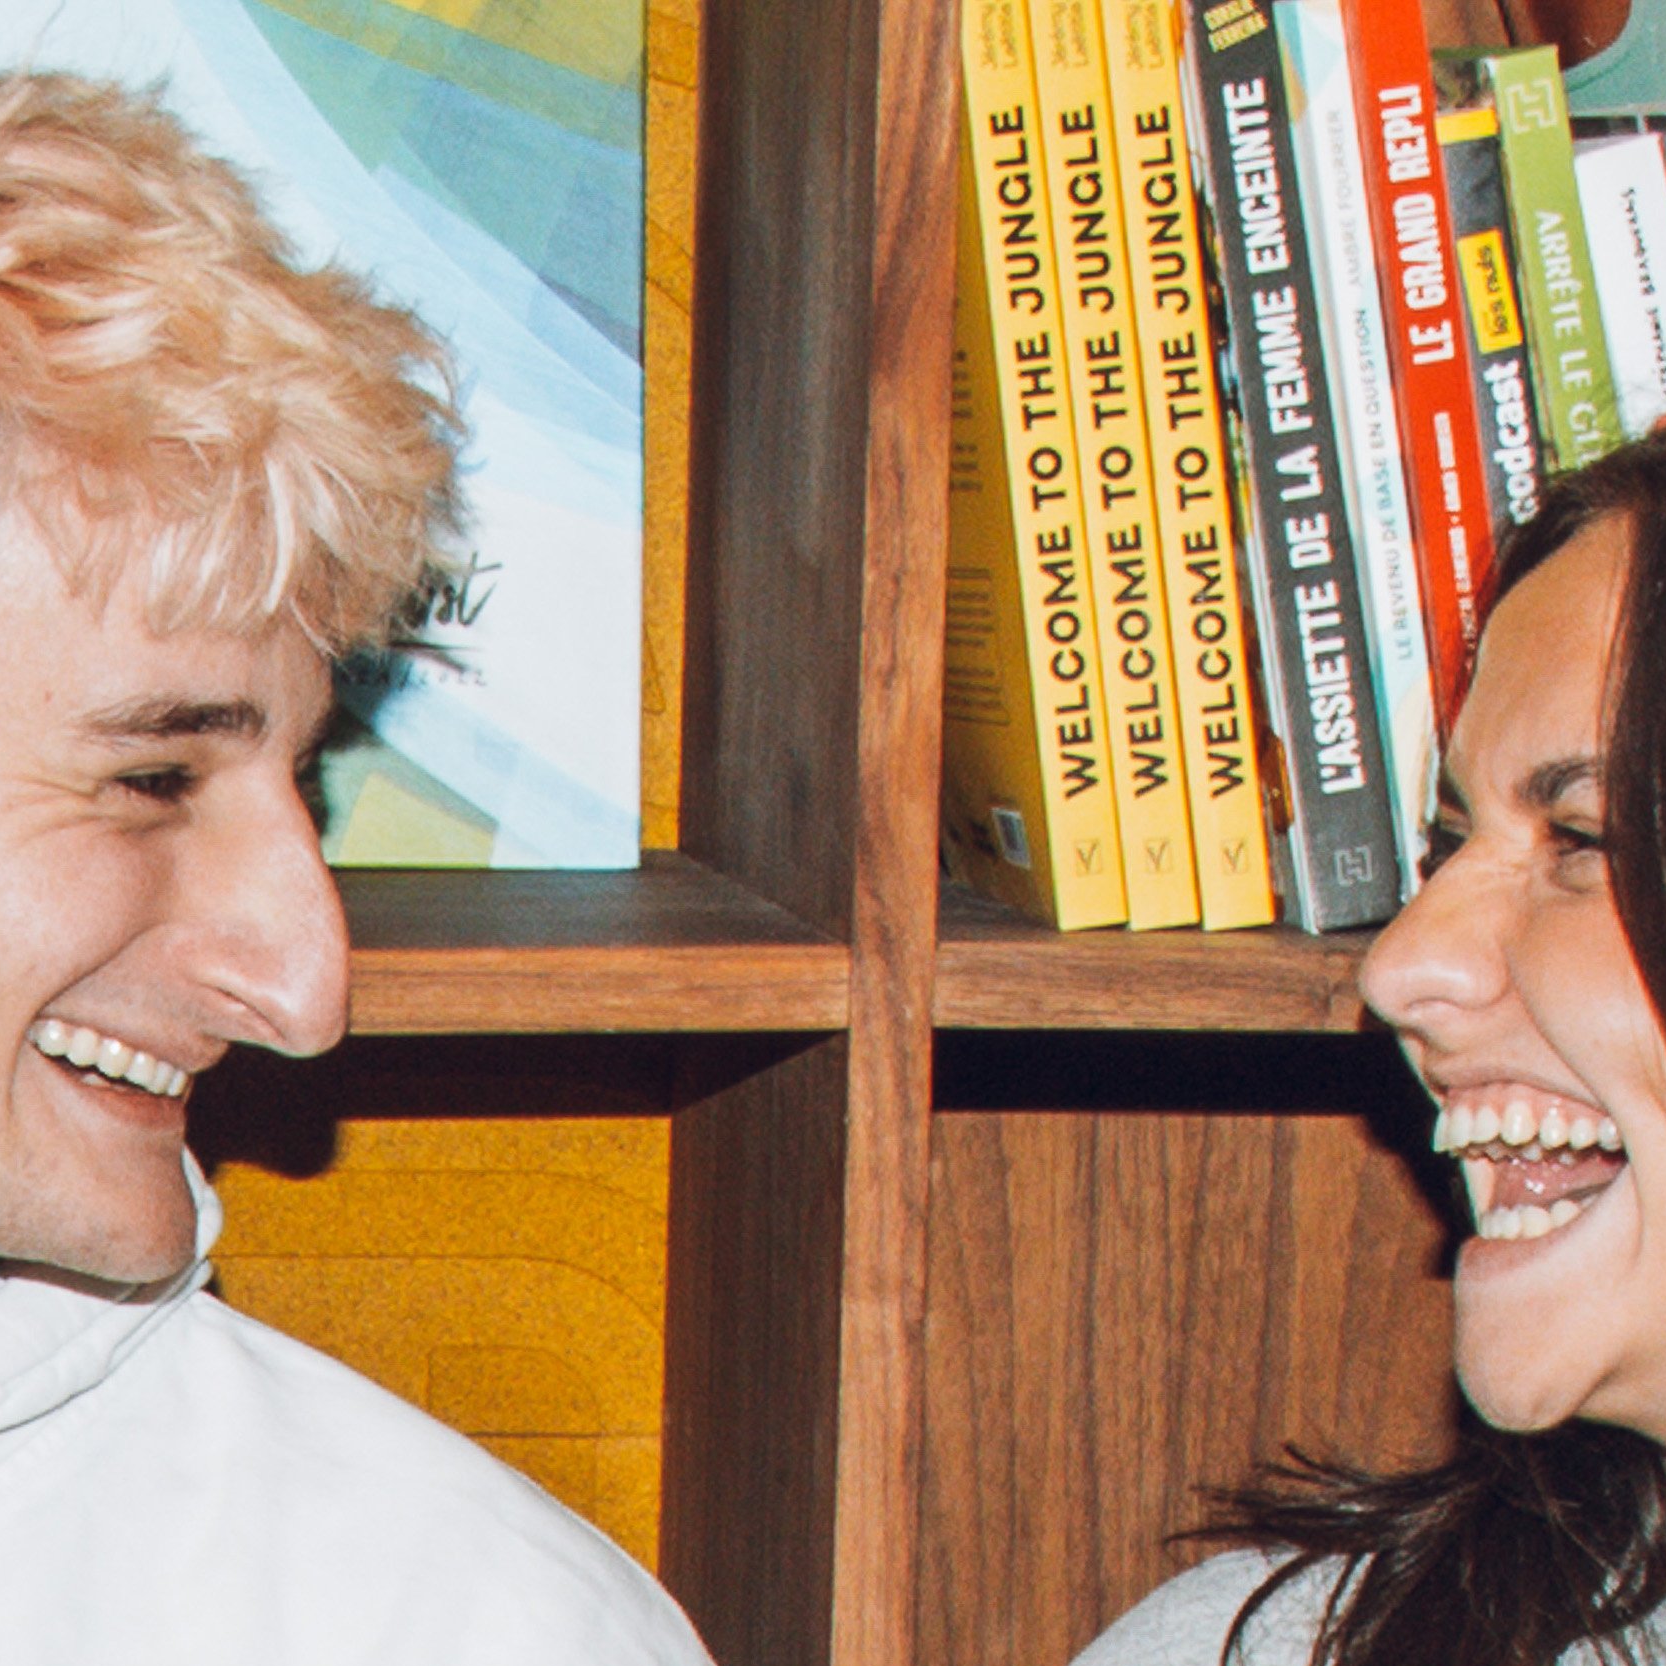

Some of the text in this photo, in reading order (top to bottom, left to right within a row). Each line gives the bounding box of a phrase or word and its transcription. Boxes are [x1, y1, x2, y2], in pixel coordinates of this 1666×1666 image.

[1222, 76, 1292, 273] ENCEINTE
[1378, 84, 1431, 184] REPLI
[1391, 192, 1448, 310] GRAND
[1412, 317, 1455, 365] LE
[1535, 210, 1583, 340] ARRÊTE
[1559, 349, 1593, 390] LE
[1254, 284, 1311, 436] FEMME
[991, 105, 1100, 798] WELCOME TO THE JUNGLE
[1062, 104, 1170, 798] WELCOME TO THE JUNGLE
[1136, 105, 1247, 798] WELCOME TO THE JUNGLE
[1277, 445, 1323, 500] LA
[1285, 512, 1330, 569] DE
[1352, 309, 1412, 660] LE REVENU DE BASE EN QUESTION
[1294, 581, 1367, 794] L'ASSIETTE
